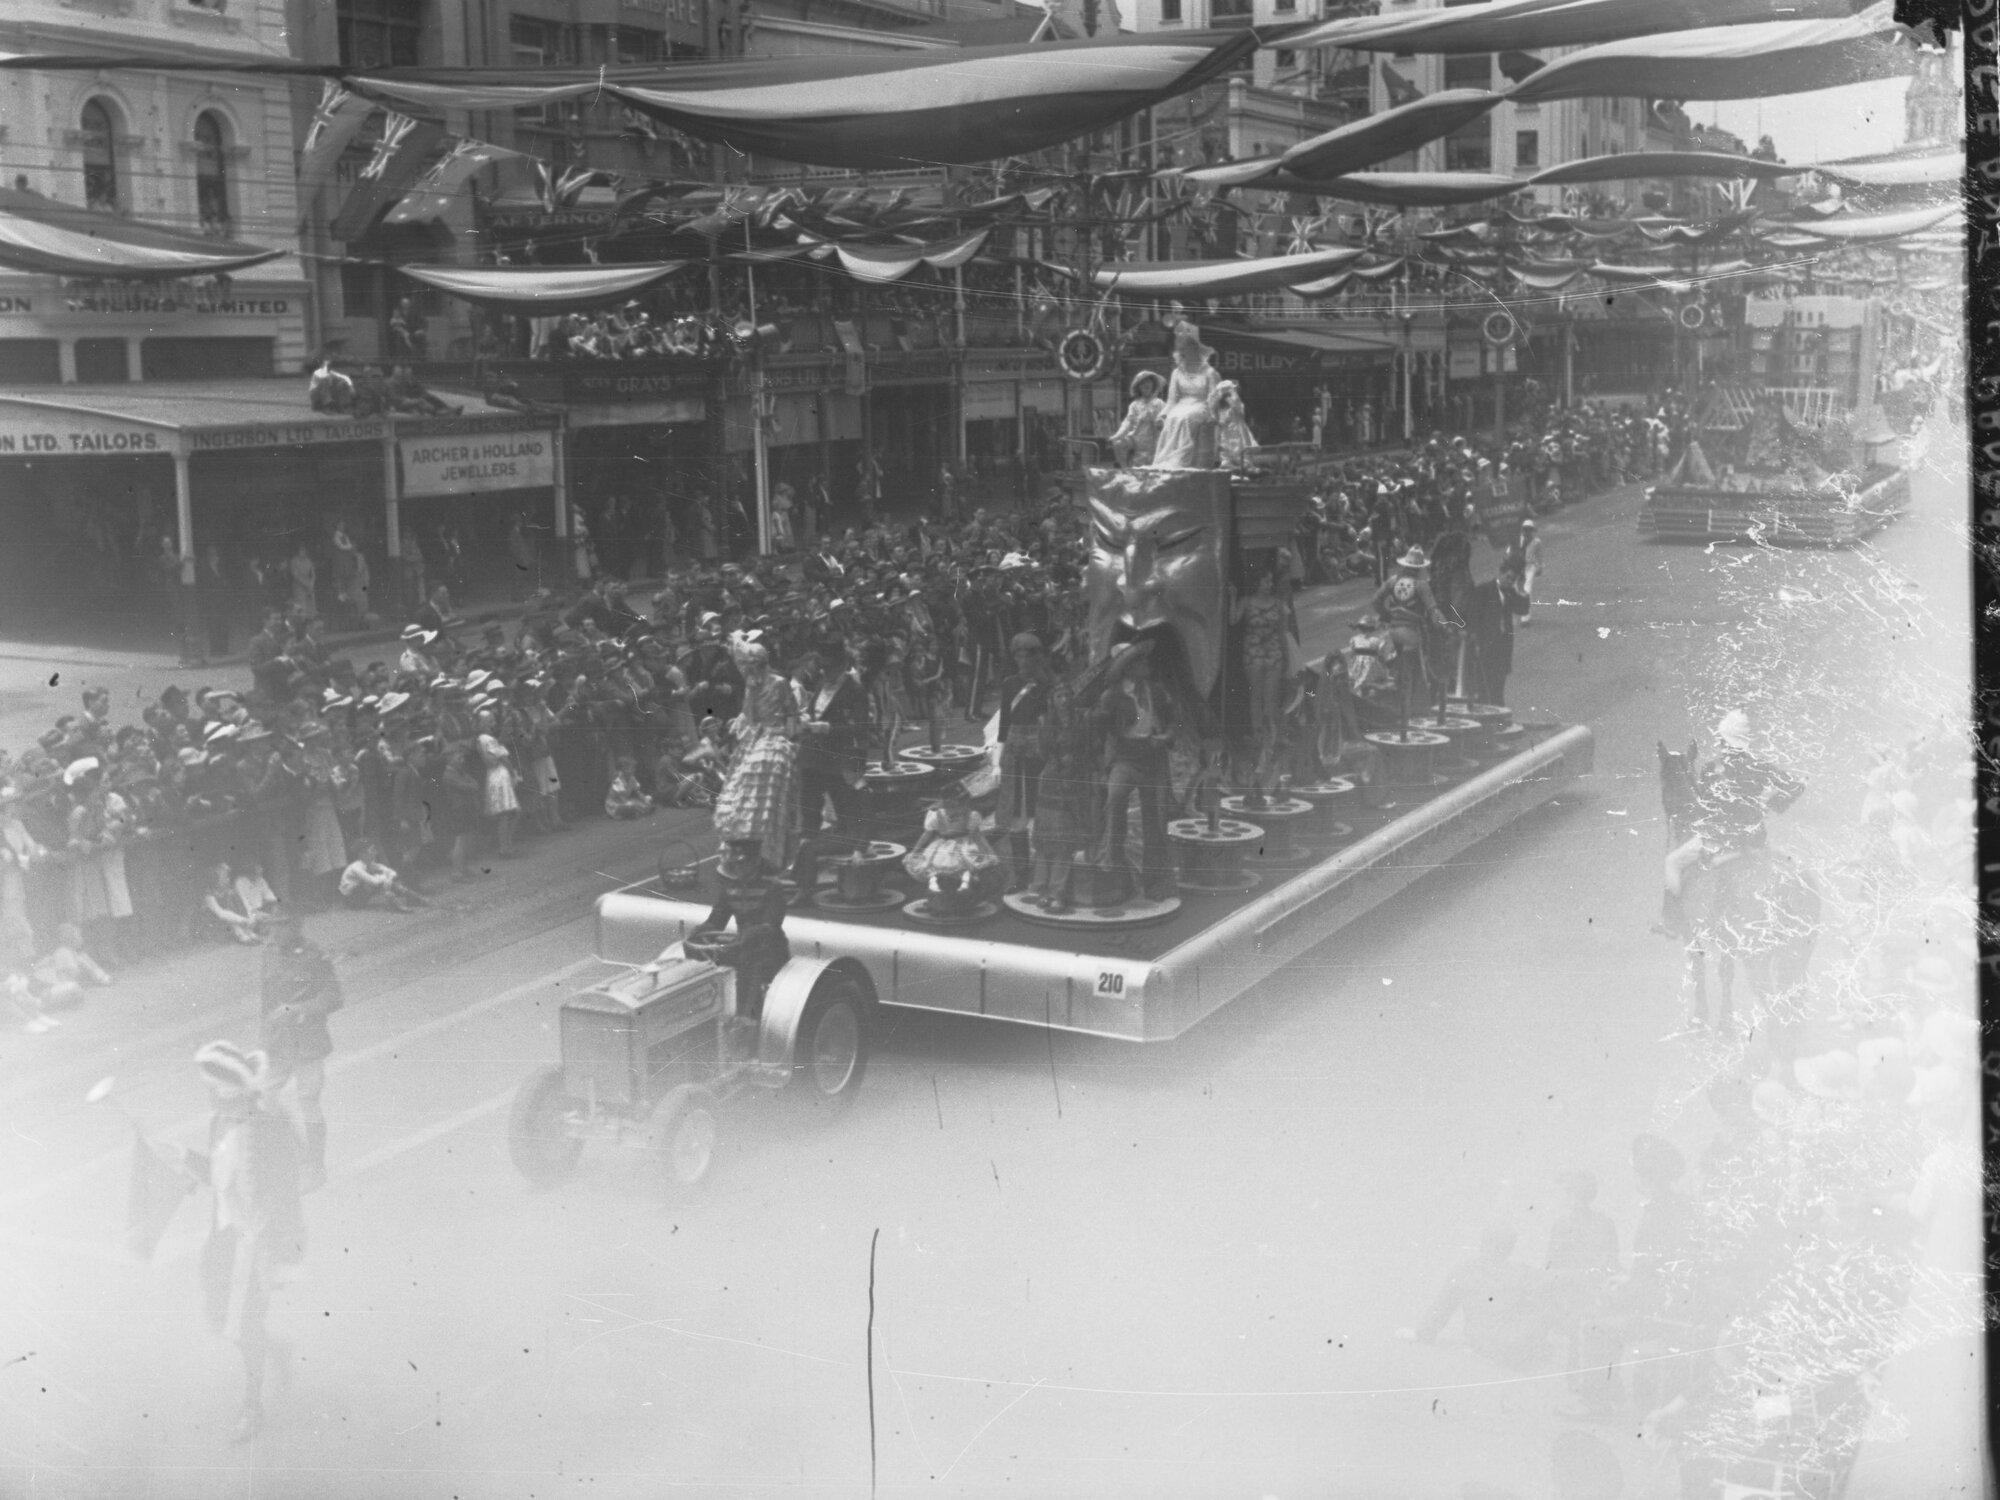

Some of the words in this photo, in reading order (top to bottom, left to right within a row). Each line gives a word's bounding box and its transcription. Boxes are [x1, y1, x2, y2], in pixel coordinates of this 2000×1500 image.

[615, 375, 672, 393] GRAYS
[193, 429, 278, 448] INGERSON
[412, 446, 469, 464] ARCHER
[473, 446, 481, 460] &
[483, 441, 544, 459] HOLLAND
[1098, 972, 1124, 994] 210
